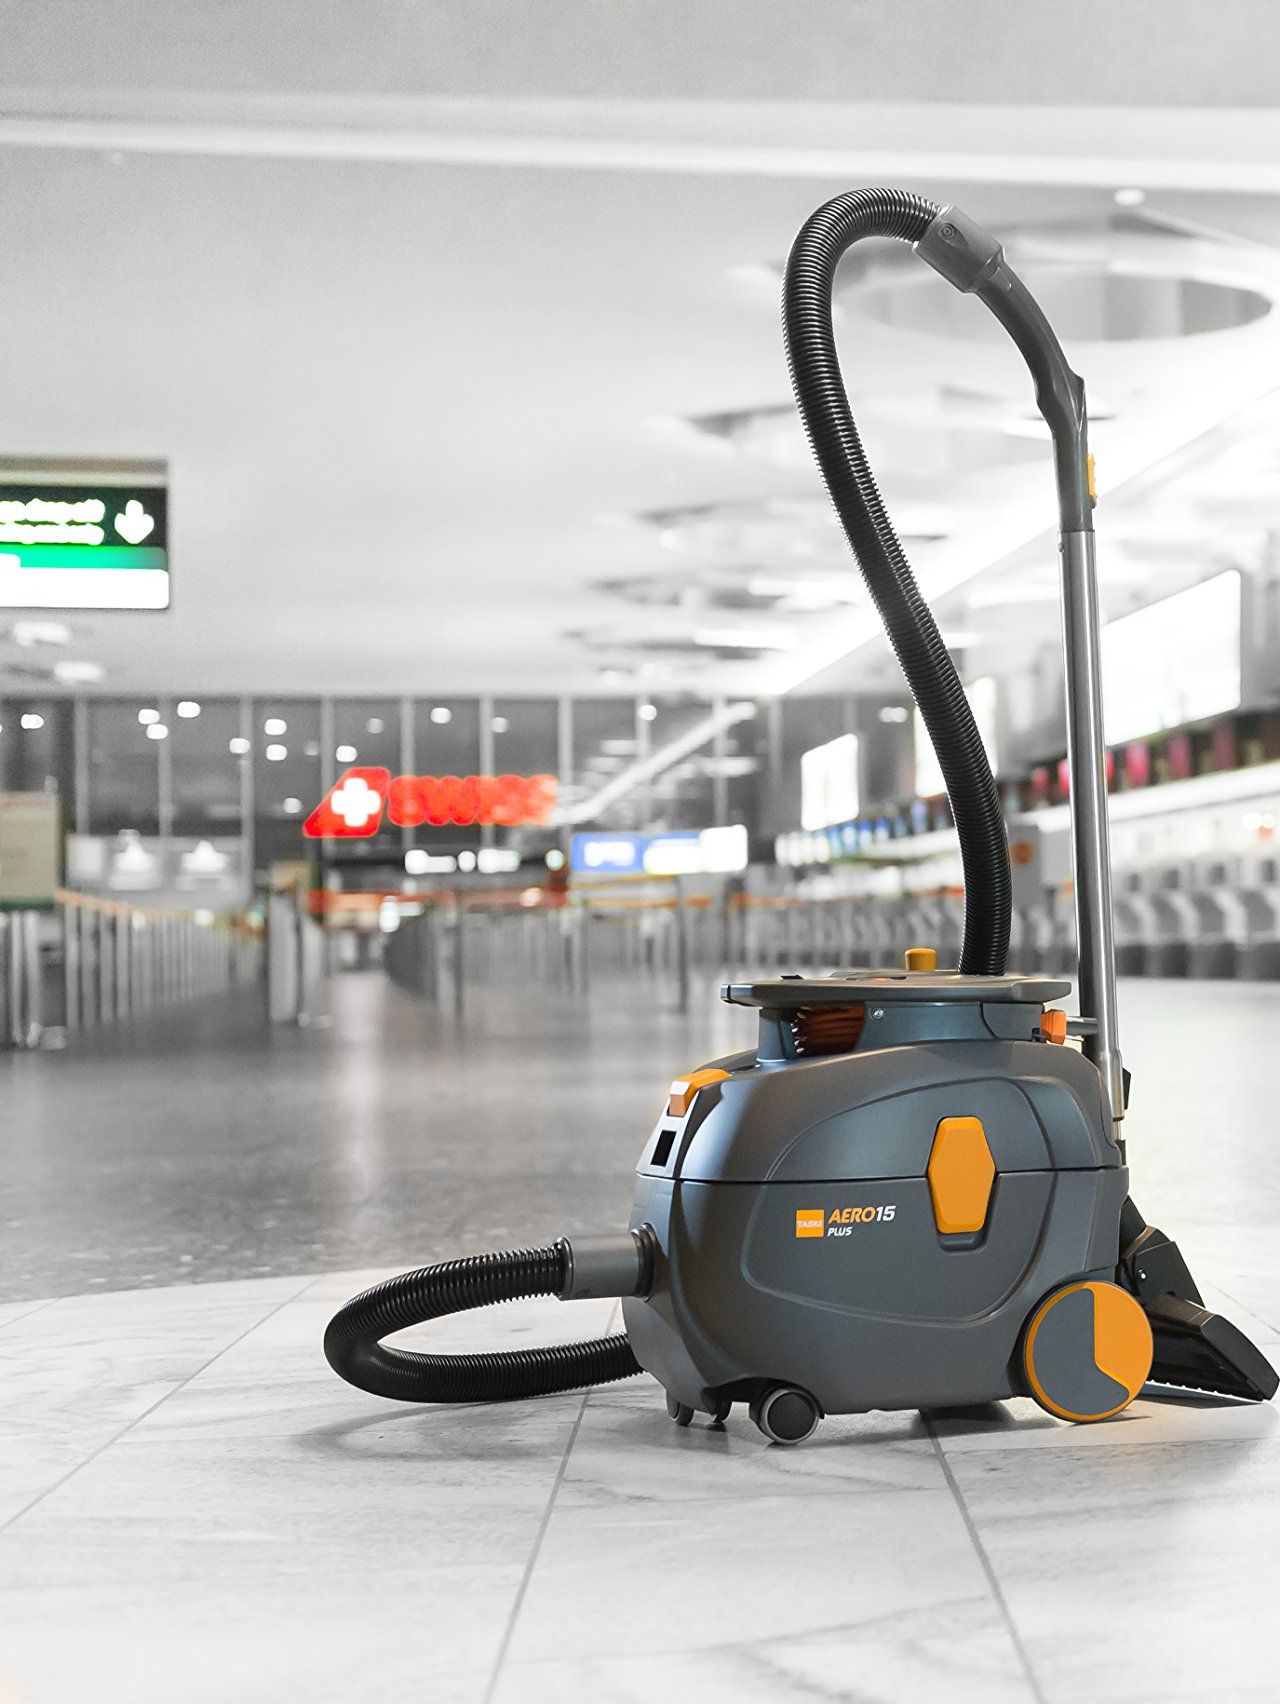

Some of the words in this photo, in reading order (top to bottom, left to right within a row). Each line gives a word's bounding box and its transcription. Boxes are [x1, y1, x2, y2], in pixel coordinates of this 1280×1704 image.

[828, 1205, 896, 1224] AERO15
[797, 1220, 822, 1229] TASKI
[827, 1226, 853, 1237] PLUS
